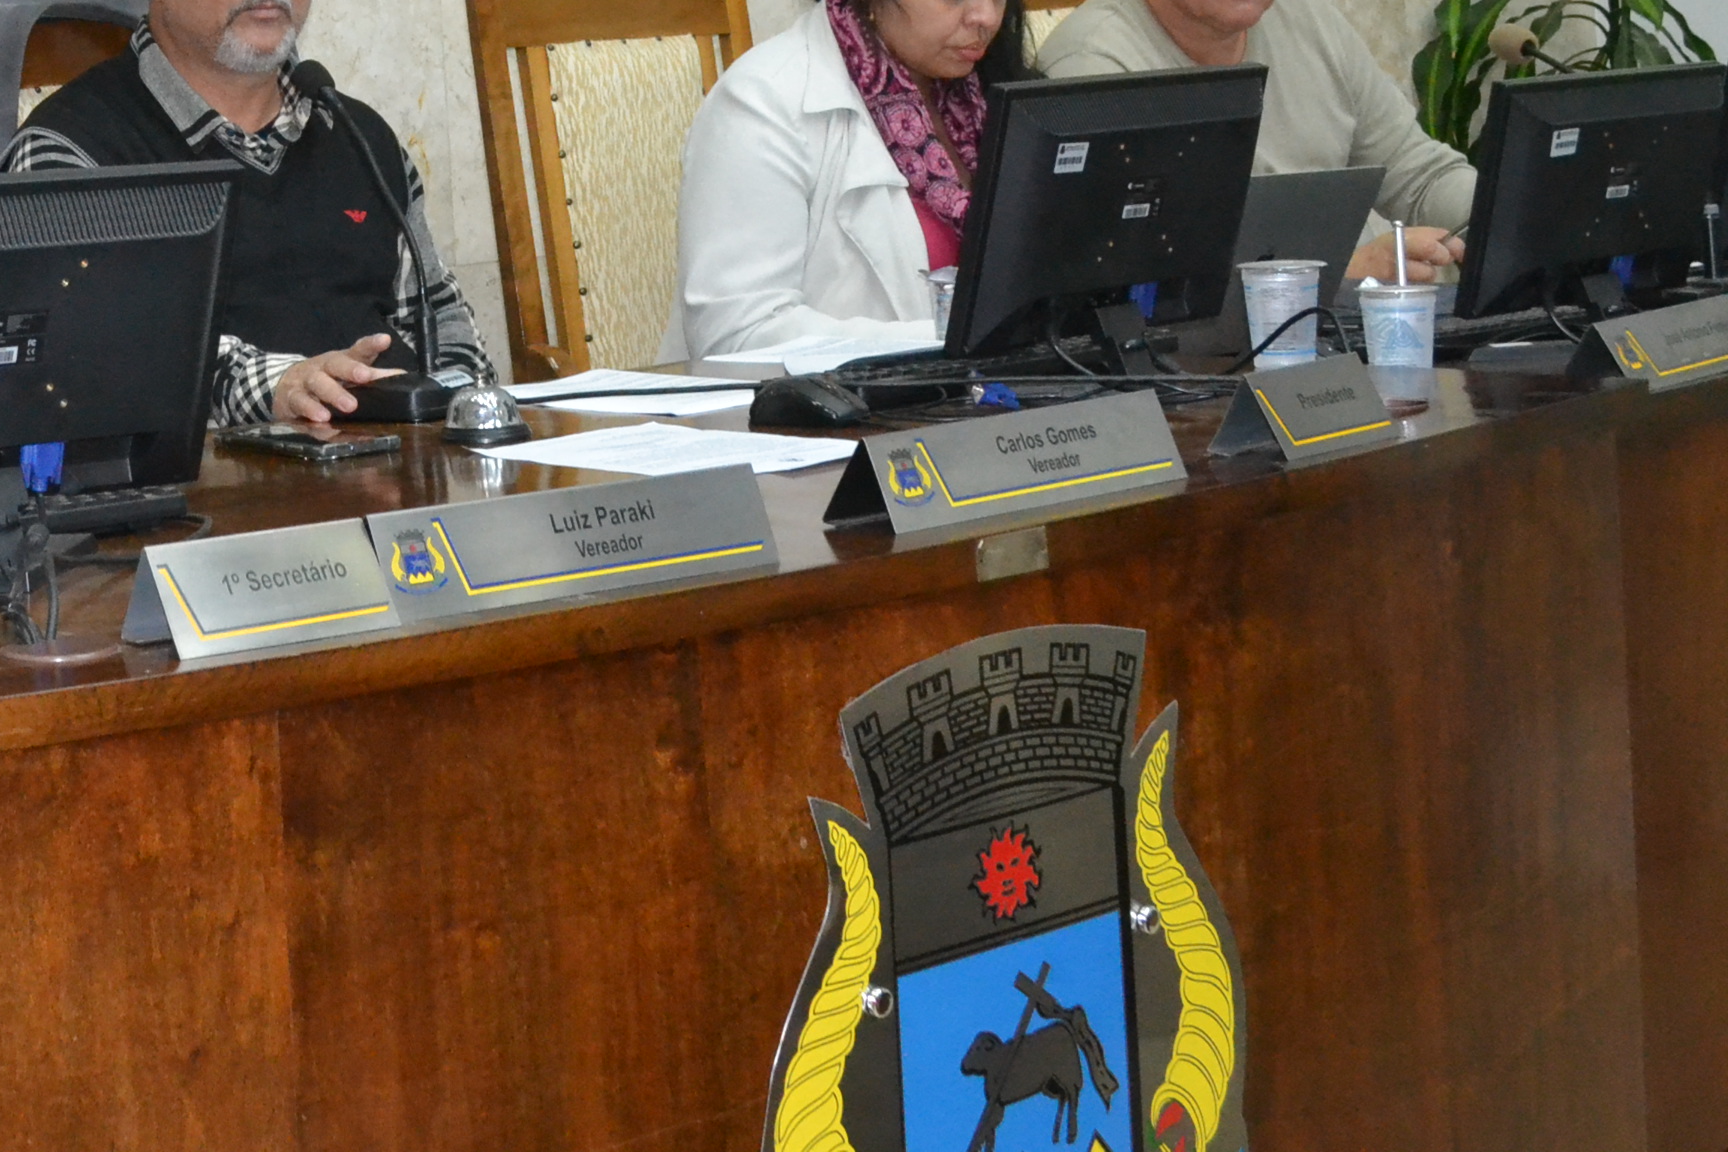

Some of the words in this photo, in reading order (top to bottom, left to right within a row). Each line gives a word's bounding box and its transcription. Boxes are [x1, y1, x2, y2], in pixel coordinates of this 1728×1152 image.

[1296, 387, 1356, 409] Presidente
[995, 431, 1044, 454] Carlos
[1045, 424, 1097, 445] Gomes
[1027, 452, 1081, 474] Vereador
[549, 509, 593, 534] Luiz
[594, 499, 656, 527] Paraki
[574, 533, 644, 558] Vereador
[245, 559, 348, 592] Secretário
